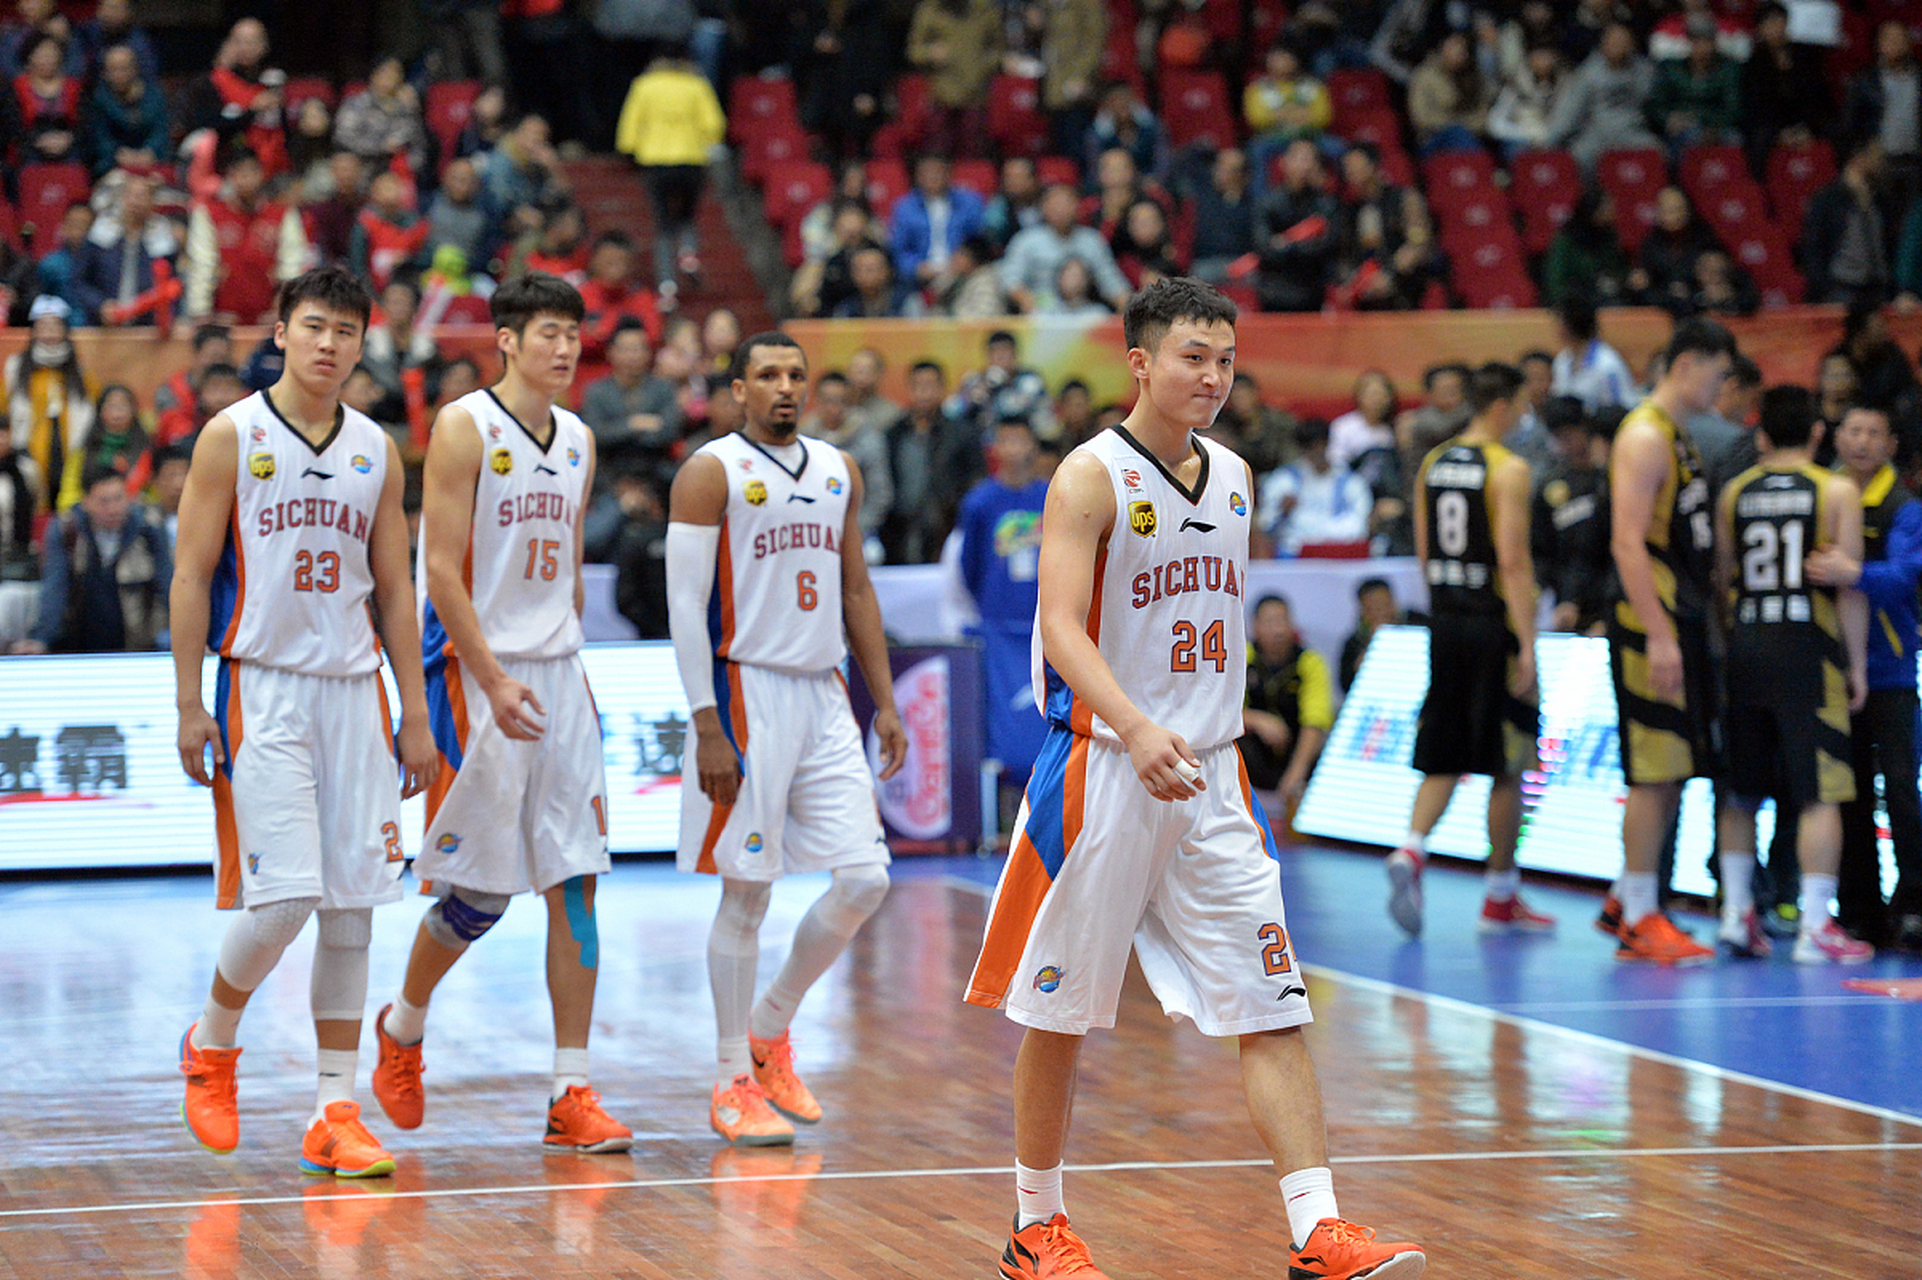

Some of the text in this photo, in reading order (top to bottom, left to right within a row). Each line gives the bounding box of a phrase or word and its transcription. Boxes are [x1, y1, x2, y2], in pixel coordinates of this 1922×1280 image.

[258, 498, 368, 543] SICHUAN
[498, 492, 577, 526] SICHU
[1132, 511, 1154, 532] ups
[1436, 490, 1469, 557] 8
[524, 538, 560, 581] 15
[754, 523, 841, 559] SICHUA
[1743, 519, 1804, 591] 21
[294, 550, 341, 593] 23
[797, 570, 818, 611] 6
[1132, 556, 1244, 609] SICHUA
[1171, 619, 1227, 673] 24
[1257, 922, 1297, 976] 2
